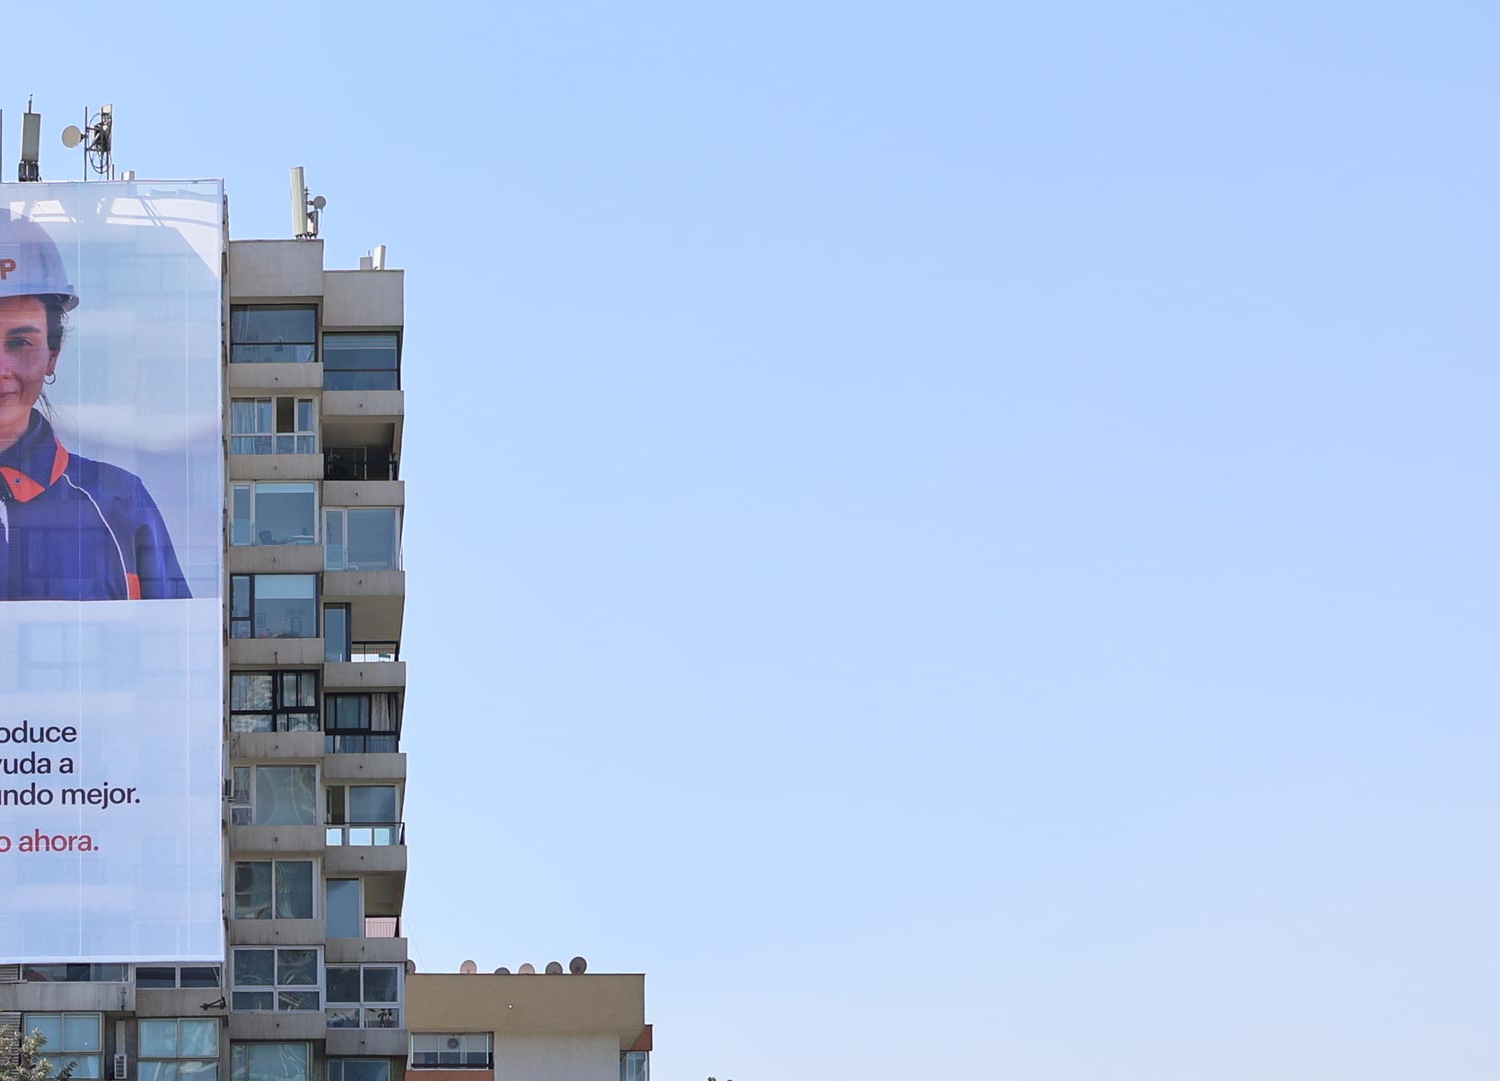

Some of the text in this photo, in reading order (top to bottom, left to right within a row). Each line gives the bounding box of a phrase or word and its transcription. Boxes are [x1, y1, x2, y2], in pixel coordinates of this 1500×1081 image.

[58, 756, 74, 774] a
[61, 781, 141, 810] mejor.
[18, 828, 99, 853] ahora.
